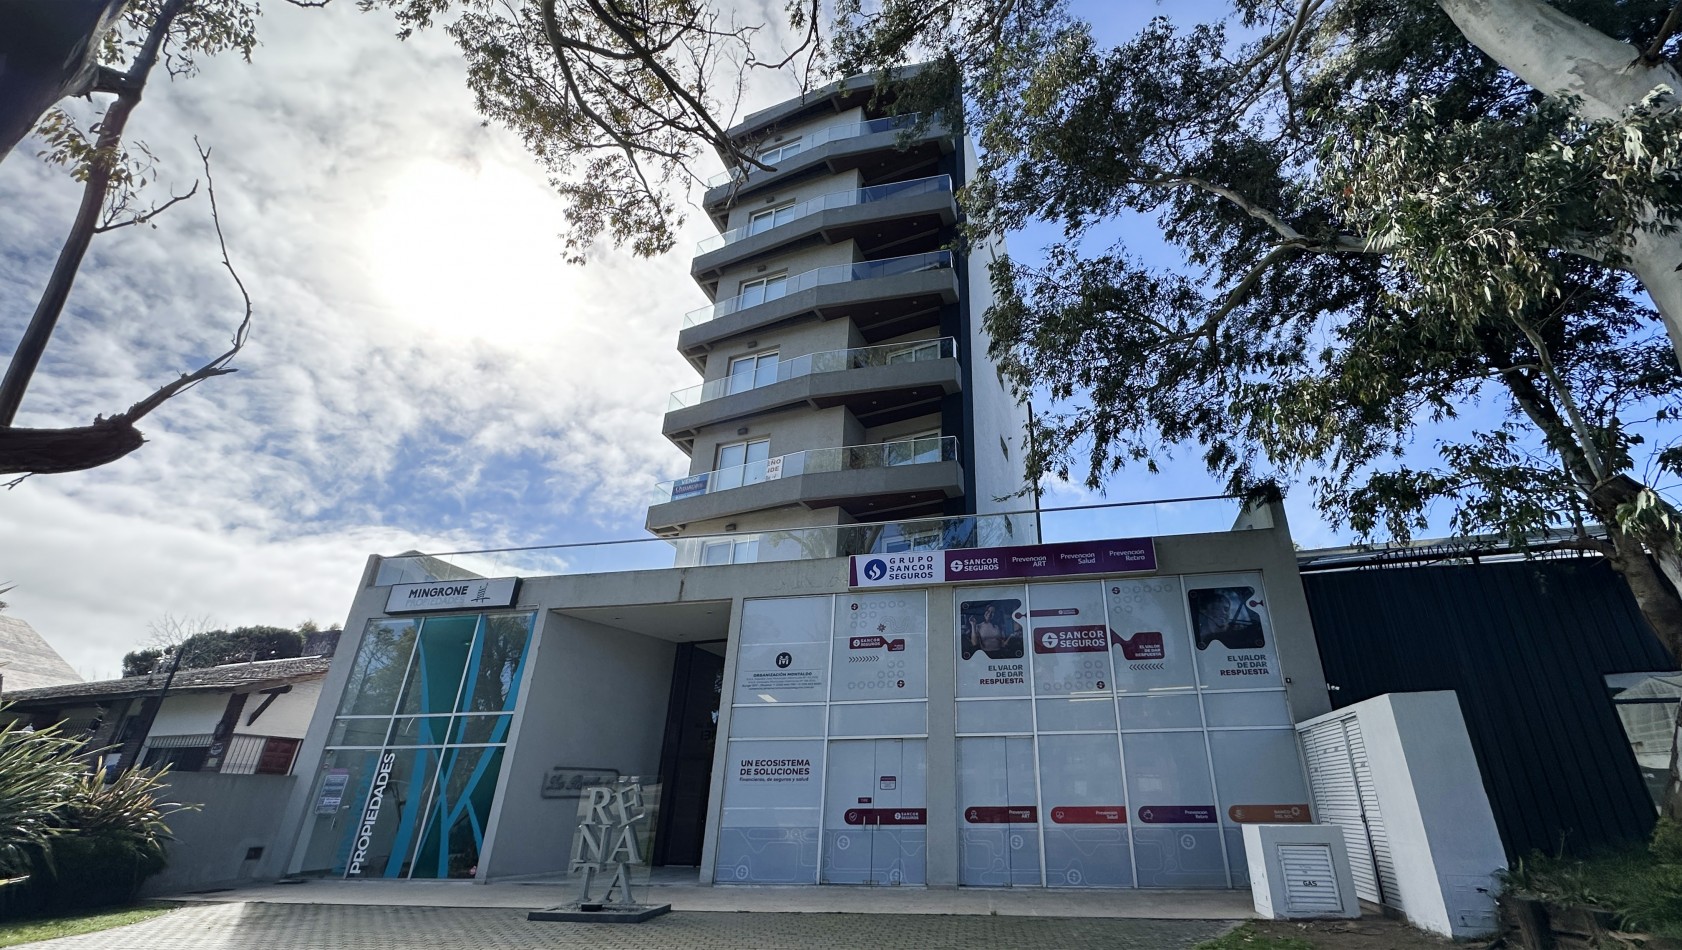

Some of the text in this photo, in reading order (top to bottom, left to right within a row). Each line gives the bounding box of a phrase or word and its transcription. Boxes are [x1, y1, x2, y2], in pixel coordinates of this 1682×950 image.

[1060, 552, 1096, 560] Prevención
[1109, 549, 1145, 557] Prevención
[889, 555, 934, 565] GRUPO
[963, 557, 999, 565] SANCOR
[1012, 555, 1047, 563] Prevención
[889, 563, 934, 573] SANCOR
[963, 563, 1000, 572] SEGUROS
[888, 571, 934, 581] SEGUROS
[408, 585, 469, 599] MINGRONE
[1059, 630, 1105, 640] SANCOR
[1060, 639, 1106, 648] SEGUROS
[1220, 668, 1269, 676] RESPUESTA
[979, 677, 1024, 685] RESPUESTA
[741, 759, 811, 767] UN ECOSISTEMA
[740, 767, 810, 776] DE SOLUCIONES
[349, 752, 396, 874] PROPIEDADES
